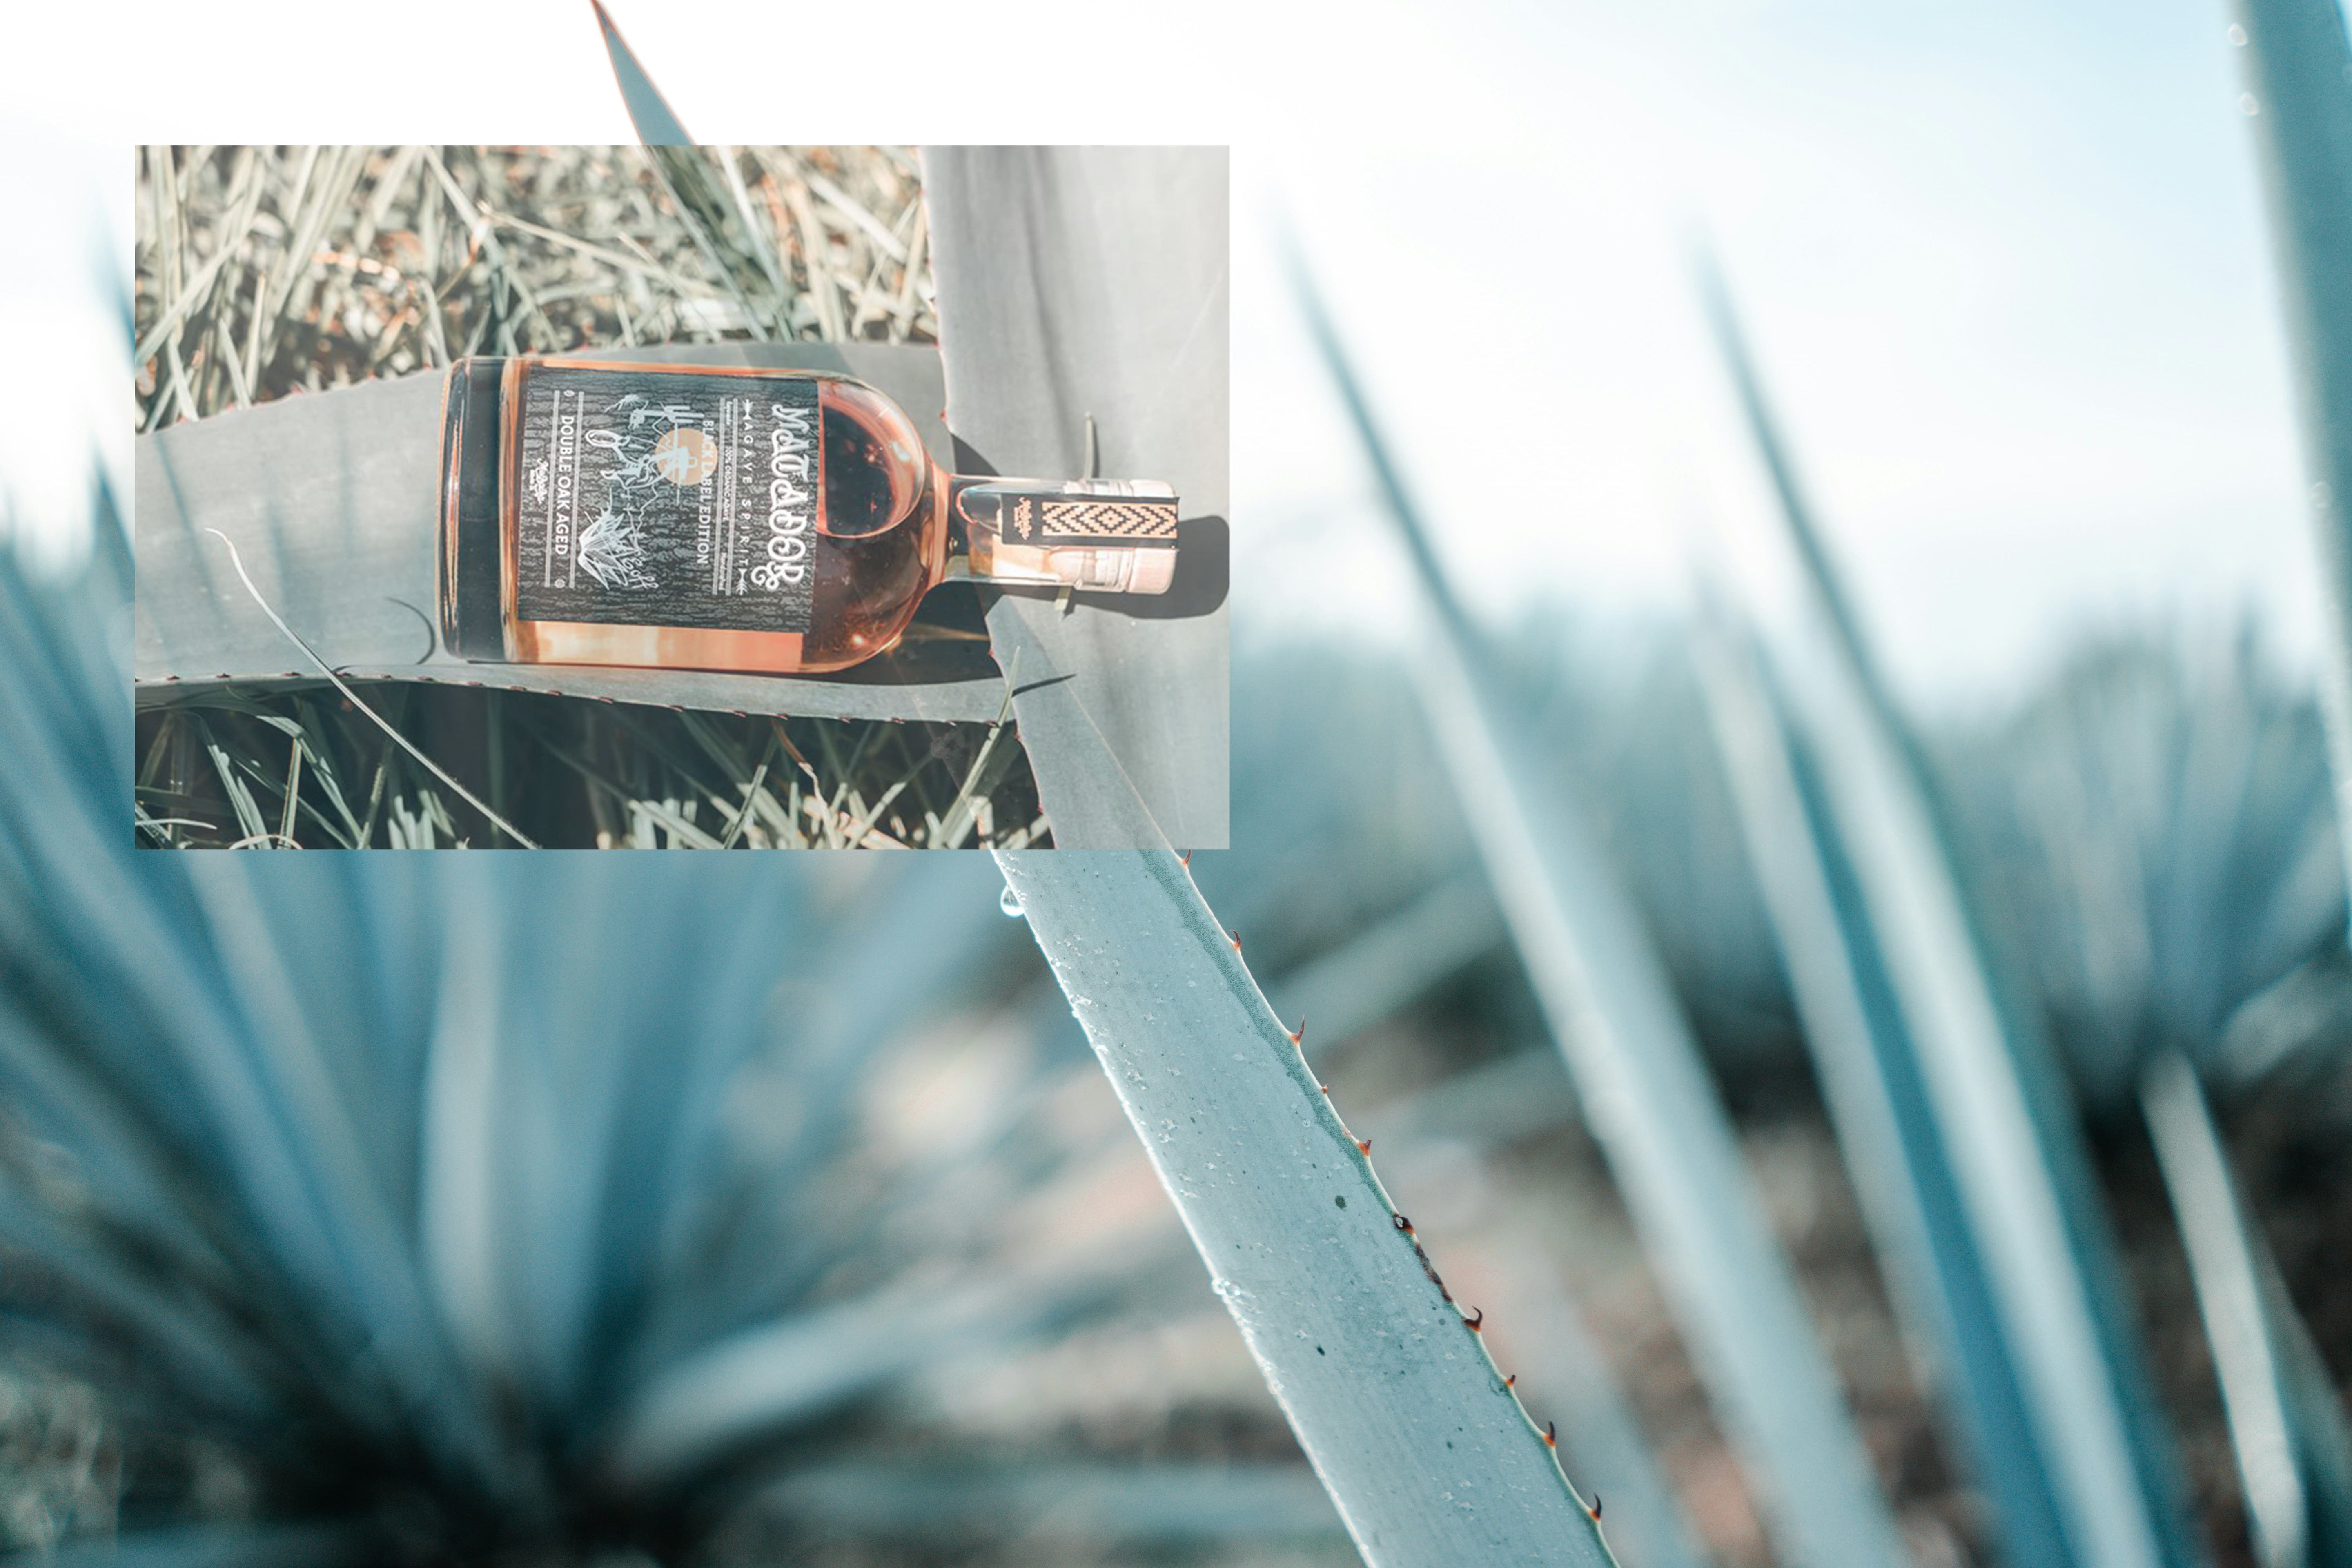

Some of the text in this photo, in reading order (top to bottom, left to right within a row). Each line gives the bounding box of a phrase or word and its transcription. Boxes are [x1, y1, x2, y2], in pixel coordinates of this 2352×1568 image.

[555, 415, 575, 555] DOUBLE OAK AGED
[696, 420, 714, 564] BLACK LABEL EDITION
[739, 422, 754, 566] AGAVE SPIRIT
[751, 403, 810, 591] MATADOR
